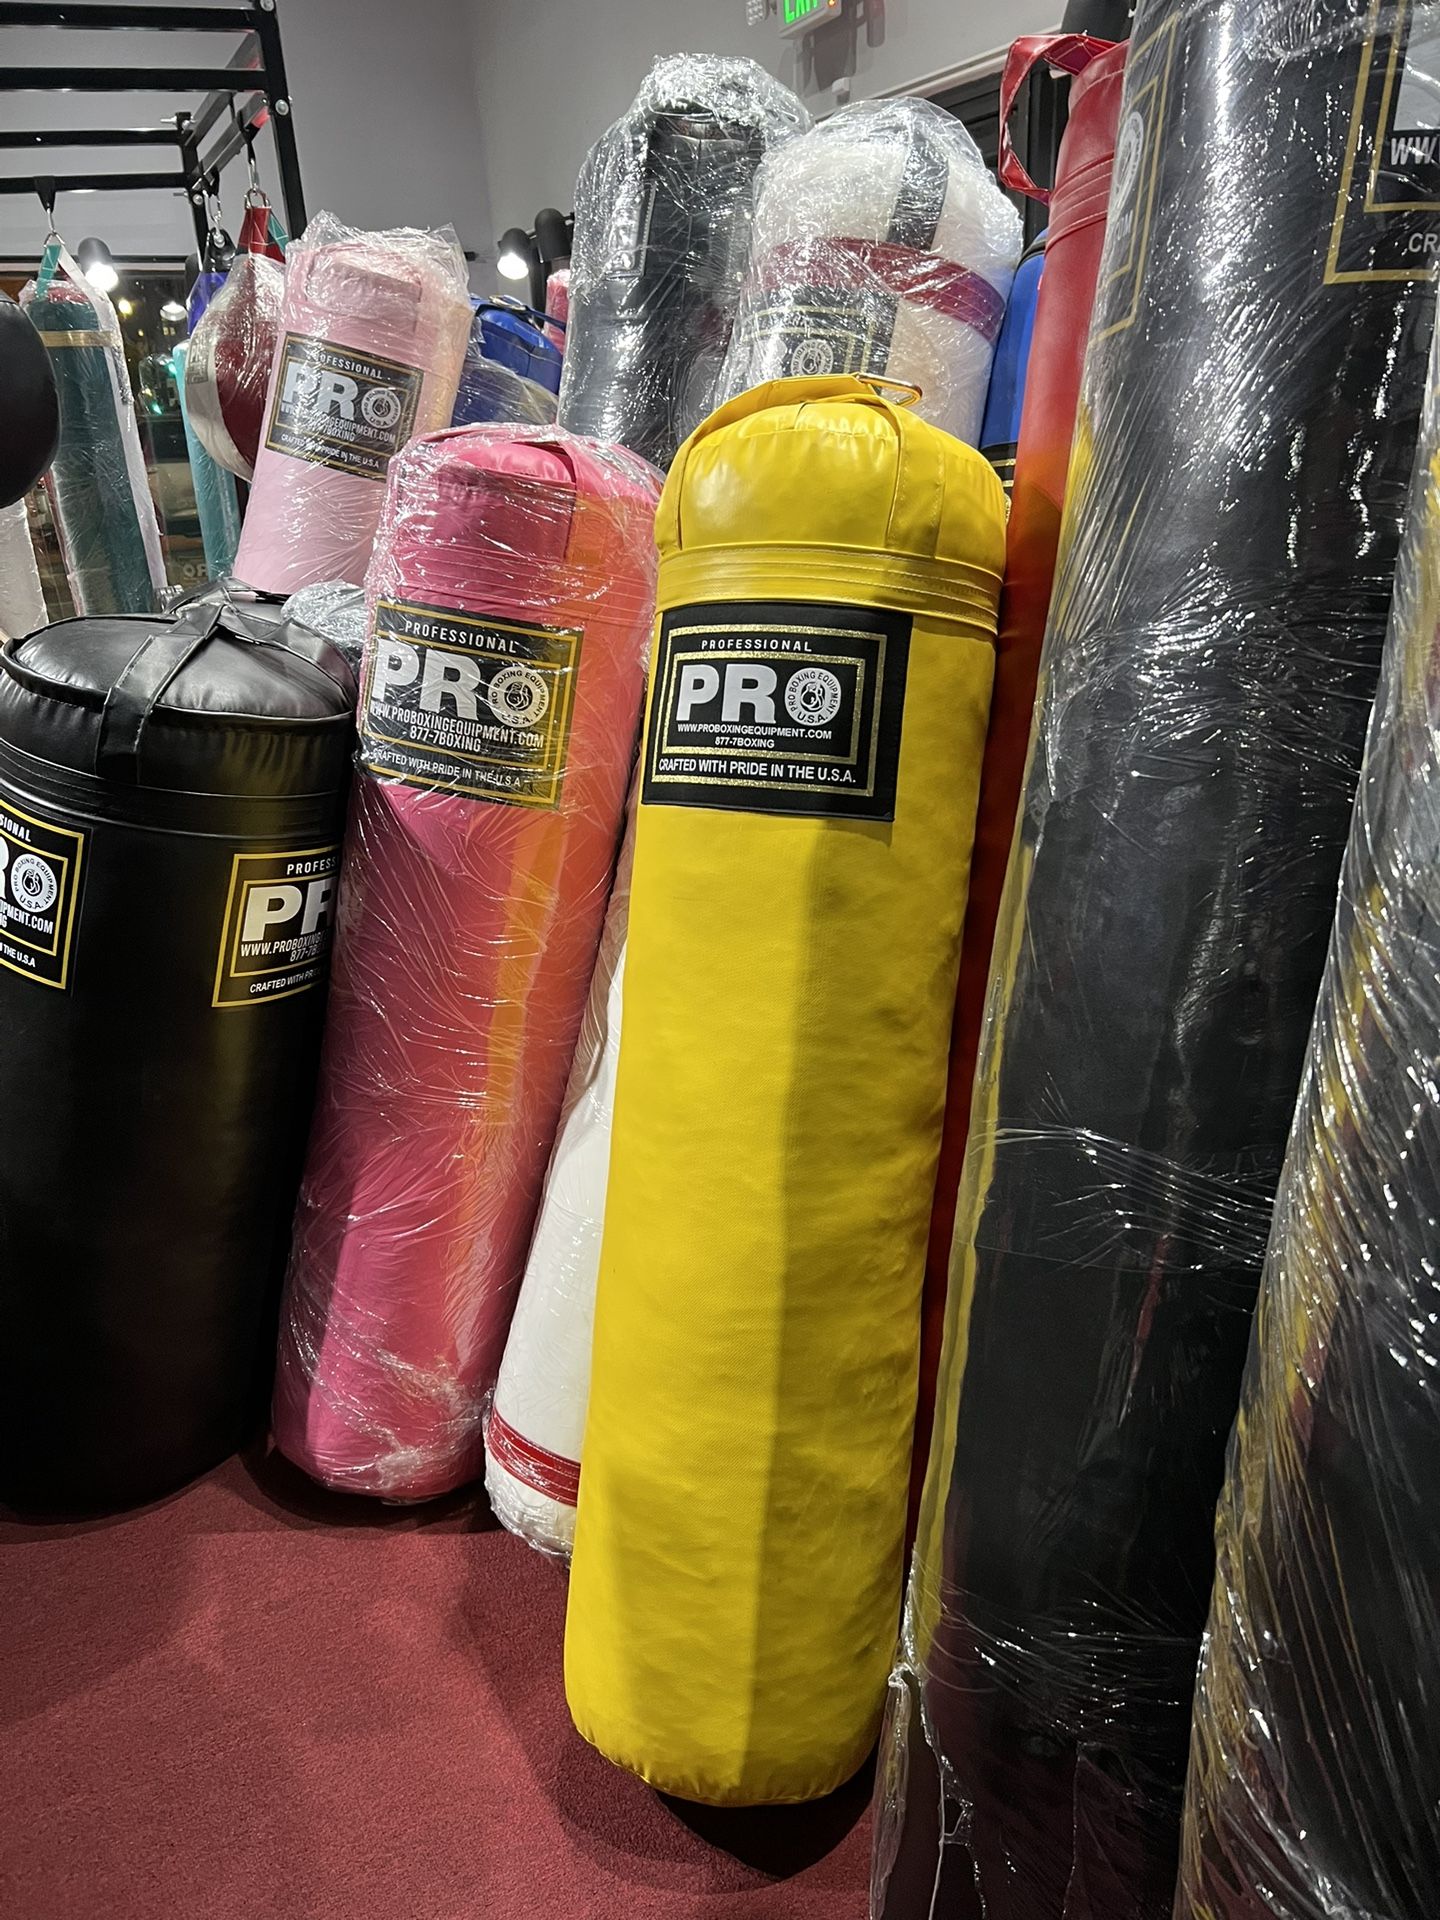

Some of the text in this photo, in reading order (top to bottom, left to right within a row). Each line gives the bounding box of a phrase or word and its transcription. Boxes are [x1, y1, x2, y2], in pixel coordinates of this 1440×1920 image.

[310, 351, 383, 380] OFESSIONAL
[404, 620, 517, 654] PROFESSIONAL
[701, 639, 812, 652] PROFESSIONAL
[788, 671, 838, 714] PRO BOXING EQUIPMENT
[797, 711, 828, 723] U.S.A.
[410, 725, 481, 752] 877-7BOXING
[677, 723, 832, 740] WWW.PROBOXINGEQUIPMENT.COM
[715, 736, 775, 749] 877-7BOXING
[462, 767, 471, 778] IN
[659, 758, 857, 783] CRAFTED WITH PRIDE IN THE U.S.A.
[250, 977, 287, 994] CRAFTED
